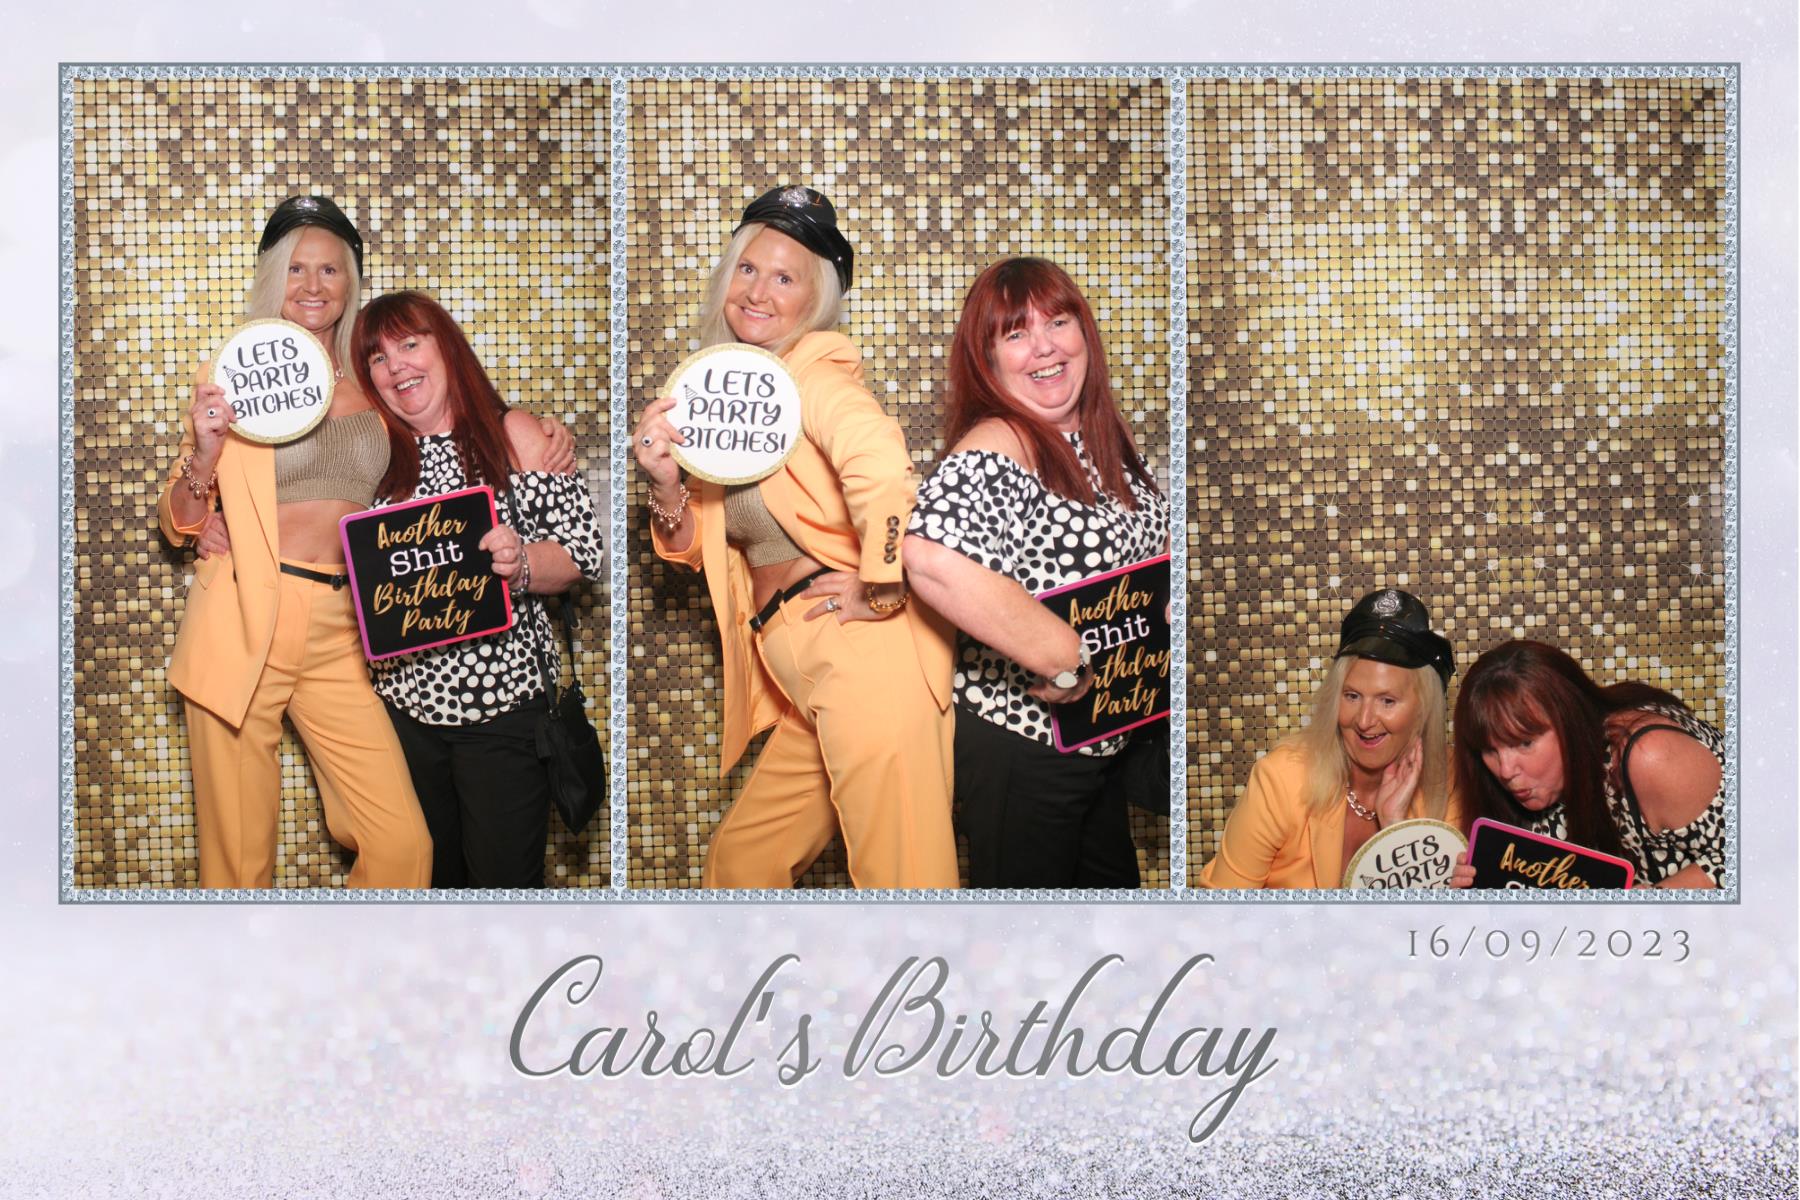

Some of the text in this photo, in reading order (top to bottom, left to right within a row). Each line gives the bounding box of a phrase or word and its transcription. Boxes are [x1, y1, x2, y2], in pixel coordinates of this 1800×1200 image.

[237, 337, 299, 369] LETS
[231, 361, 310, 396] PARTY
[704, 368, 776, 398] LETS
[230, 385, 324, 420] BITCHES!
[688, 396, 782, 426] PARTY
[678, 426, 787, 455] BITCHES!
[377, 502, 468, 550] Another
[389, 540, 464, 578] Shit
[373, 566, 492, 616] Birthday
[1069, 573, 1153, 628] Another
[401, 599, 475, 637] Party
[1080, 614, 1150, 656] Shit
[1090, 643, 1171, 690] rthday
[1091, 677, 1160, 725] Party
[1375, 835, 1440, 874] LETS
